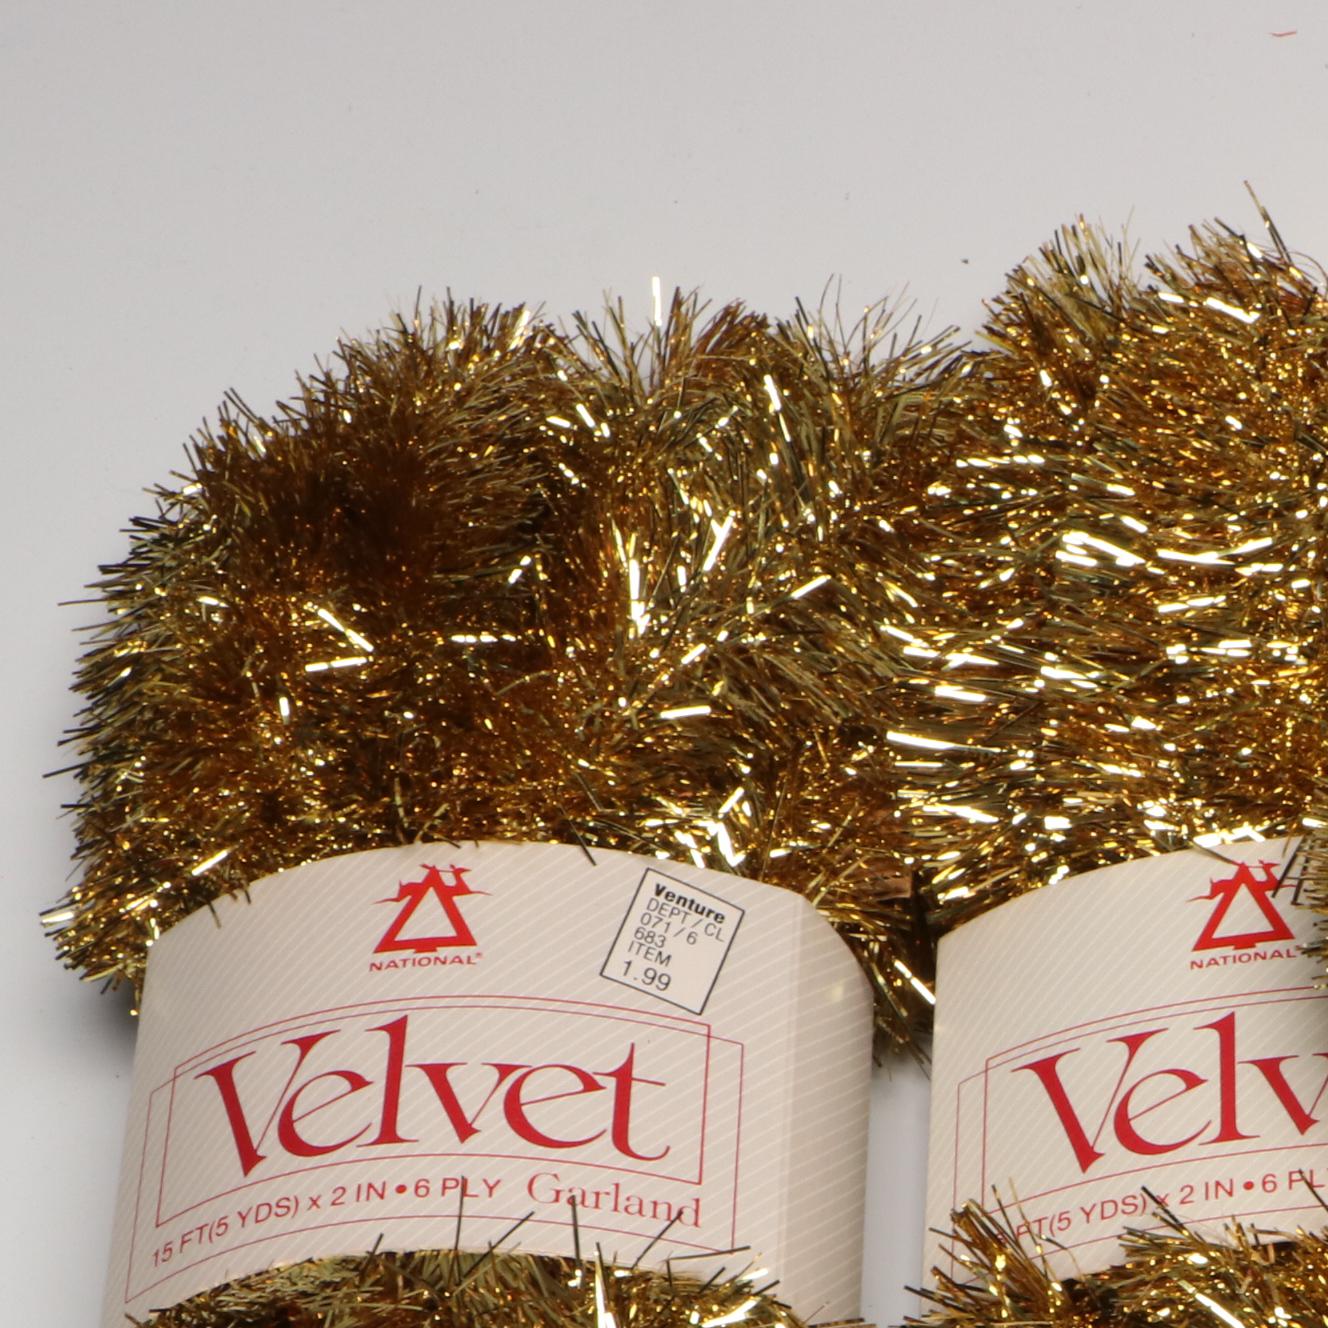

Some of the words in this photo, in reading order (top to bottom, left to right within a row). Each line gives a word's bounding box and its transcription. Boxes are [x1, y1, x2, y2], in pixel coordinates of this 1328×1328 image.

[654, 883, 725, 924] Venture
[627, 940, 672, 967] ITEM
[634, 926, 667, 949] 683
[622, 960, 672, 991] 1.99
[1190, 948, 1297, 970] NATIONAL
[194, 1015, 671, 1178] Velvet
[152, 1241, 173, 1267] 15
[237, 1196, 300, 1228] YDS)
[307, 1195, 321, 1211] x
[330, 1186, 347, 1206] 2
[441, 1177, 501, 1198] PLY
[527, 1172, 701, 1227] Garland
[1080, 1193, 1147, 1224] YDS)
[1179, 1184, 1195, 1205] 2
